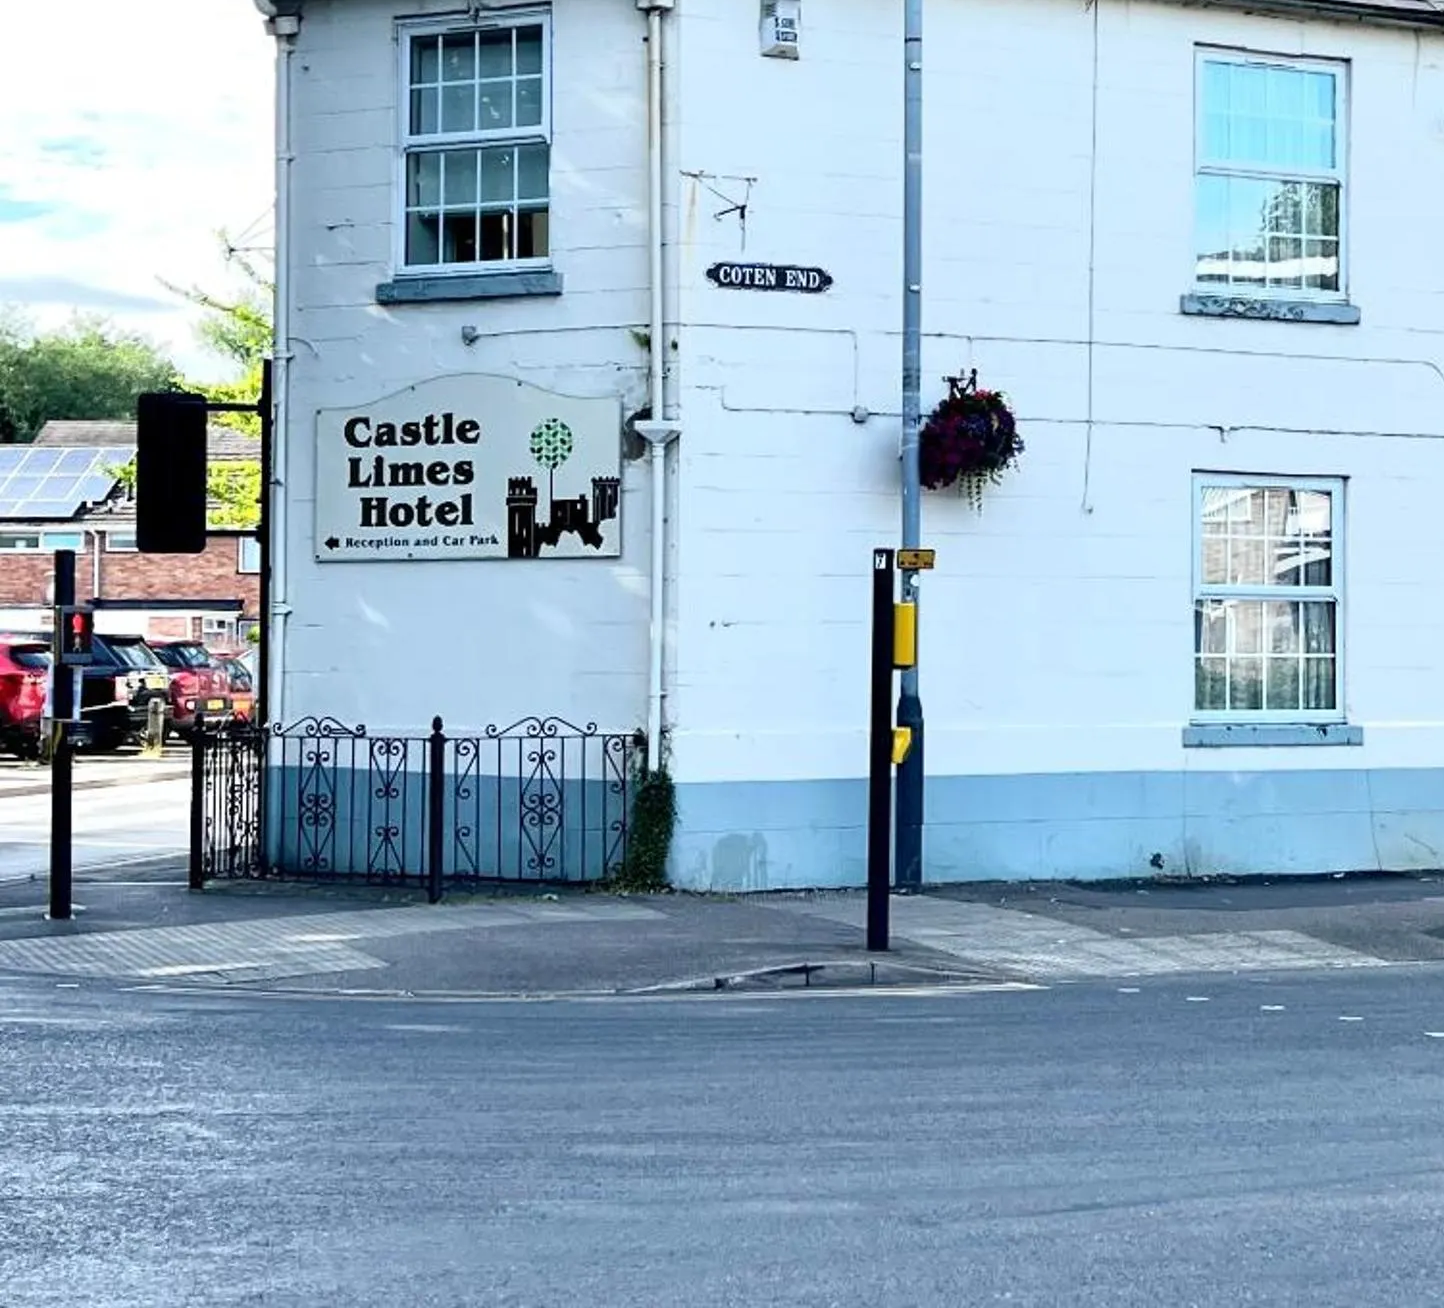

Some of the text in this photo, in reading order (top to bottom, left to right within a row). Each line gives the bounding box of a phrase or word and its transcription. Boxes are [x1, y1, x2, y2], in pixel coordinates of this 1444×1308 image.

[719, 266, 820, 289] COTEN END
[344, 412, 480, 448] Castle
[347, 455, 474, 488] Limes
[359, 493, 474, 527] Hotel
[345, 534, 499, 549] Reception and Car Park
